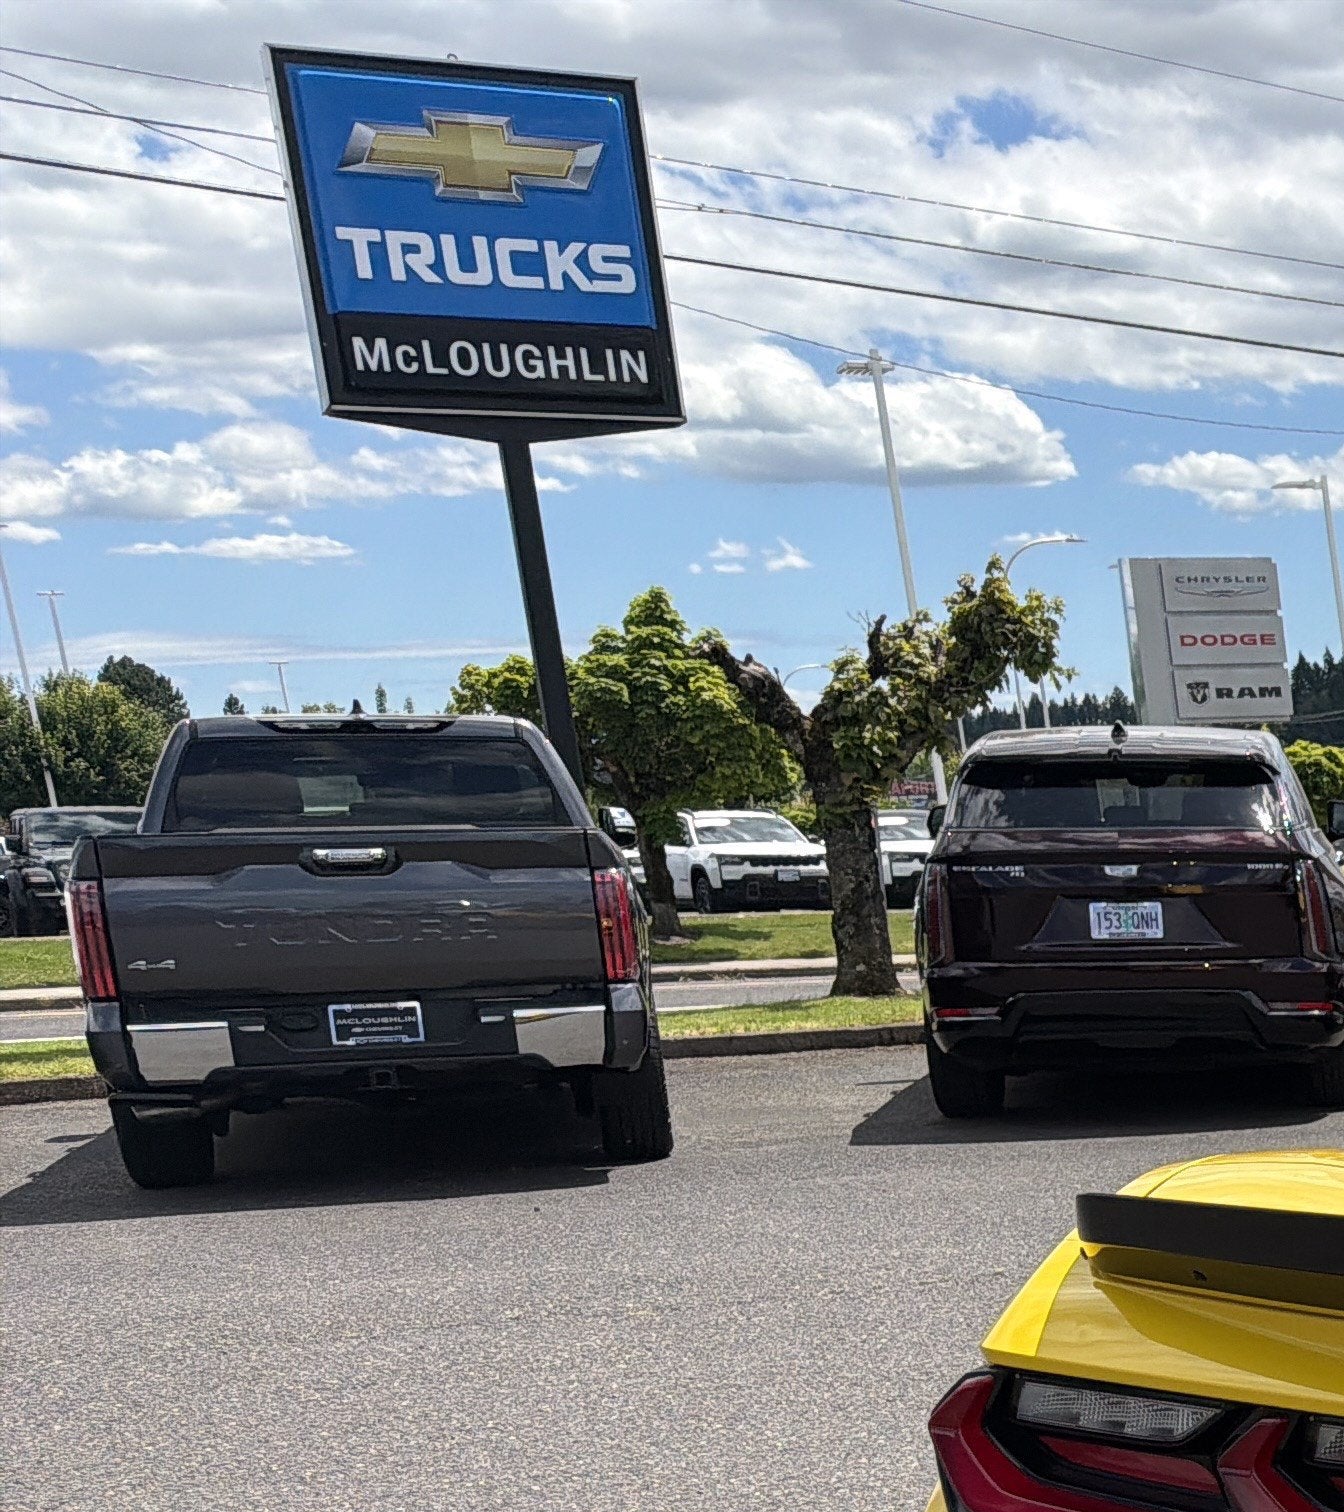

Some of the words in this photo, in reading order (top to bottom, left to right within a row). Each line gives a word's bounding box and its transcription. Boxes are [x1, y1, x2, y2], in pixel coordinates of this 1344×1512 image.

[335, 226, 637, 294] TRUCKS
[350, 336, 650, 384] McLOUGHLIN
[1174, 575, 1267, 584] CHRYSLER
[1179, 633, 1277, 647] DODGE
[1215, 685, 1283, 699] RAM
[1097, 911, 1122, 930] 153
